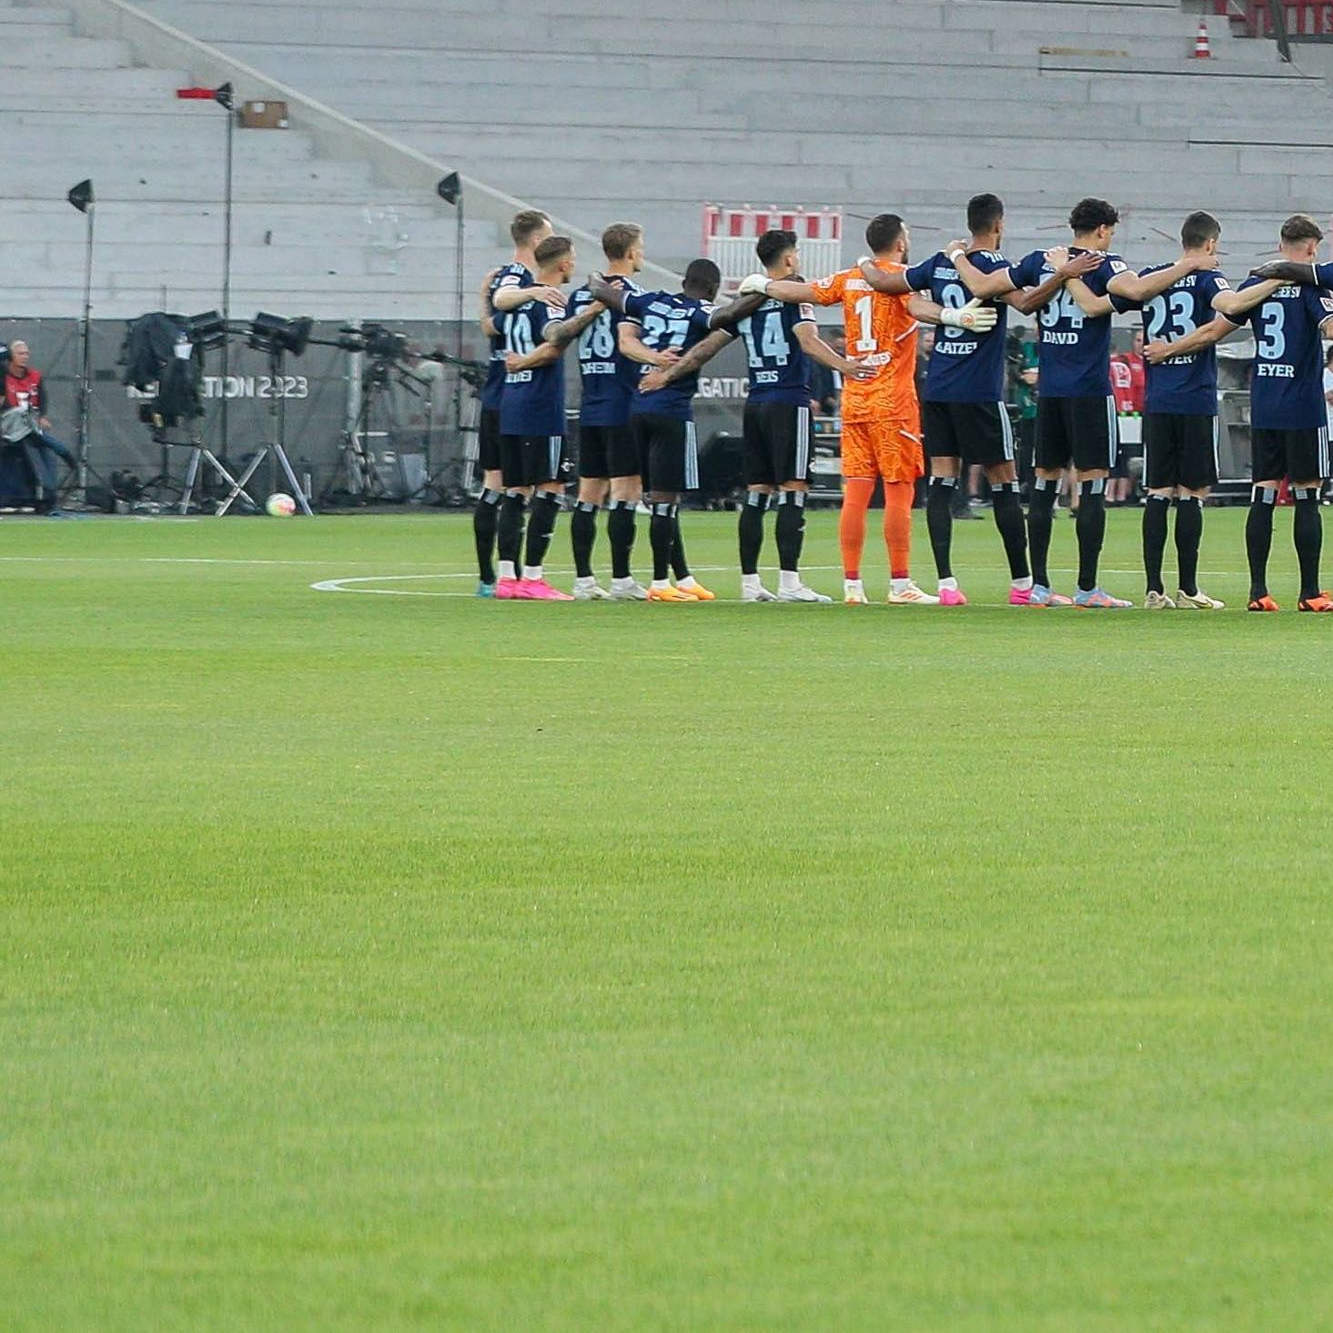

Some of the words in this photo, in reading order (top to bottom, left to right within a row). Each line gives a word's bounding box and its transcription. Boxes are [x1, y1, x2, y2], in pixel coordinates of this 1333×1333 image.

[503, 312, 541, 360] 10
[737, 312, 791, 368] 14
[854, 295, 878, 352] 1
[1142, 290, 1198, 345] 23
[1258, 302, 1286, 361] 3
